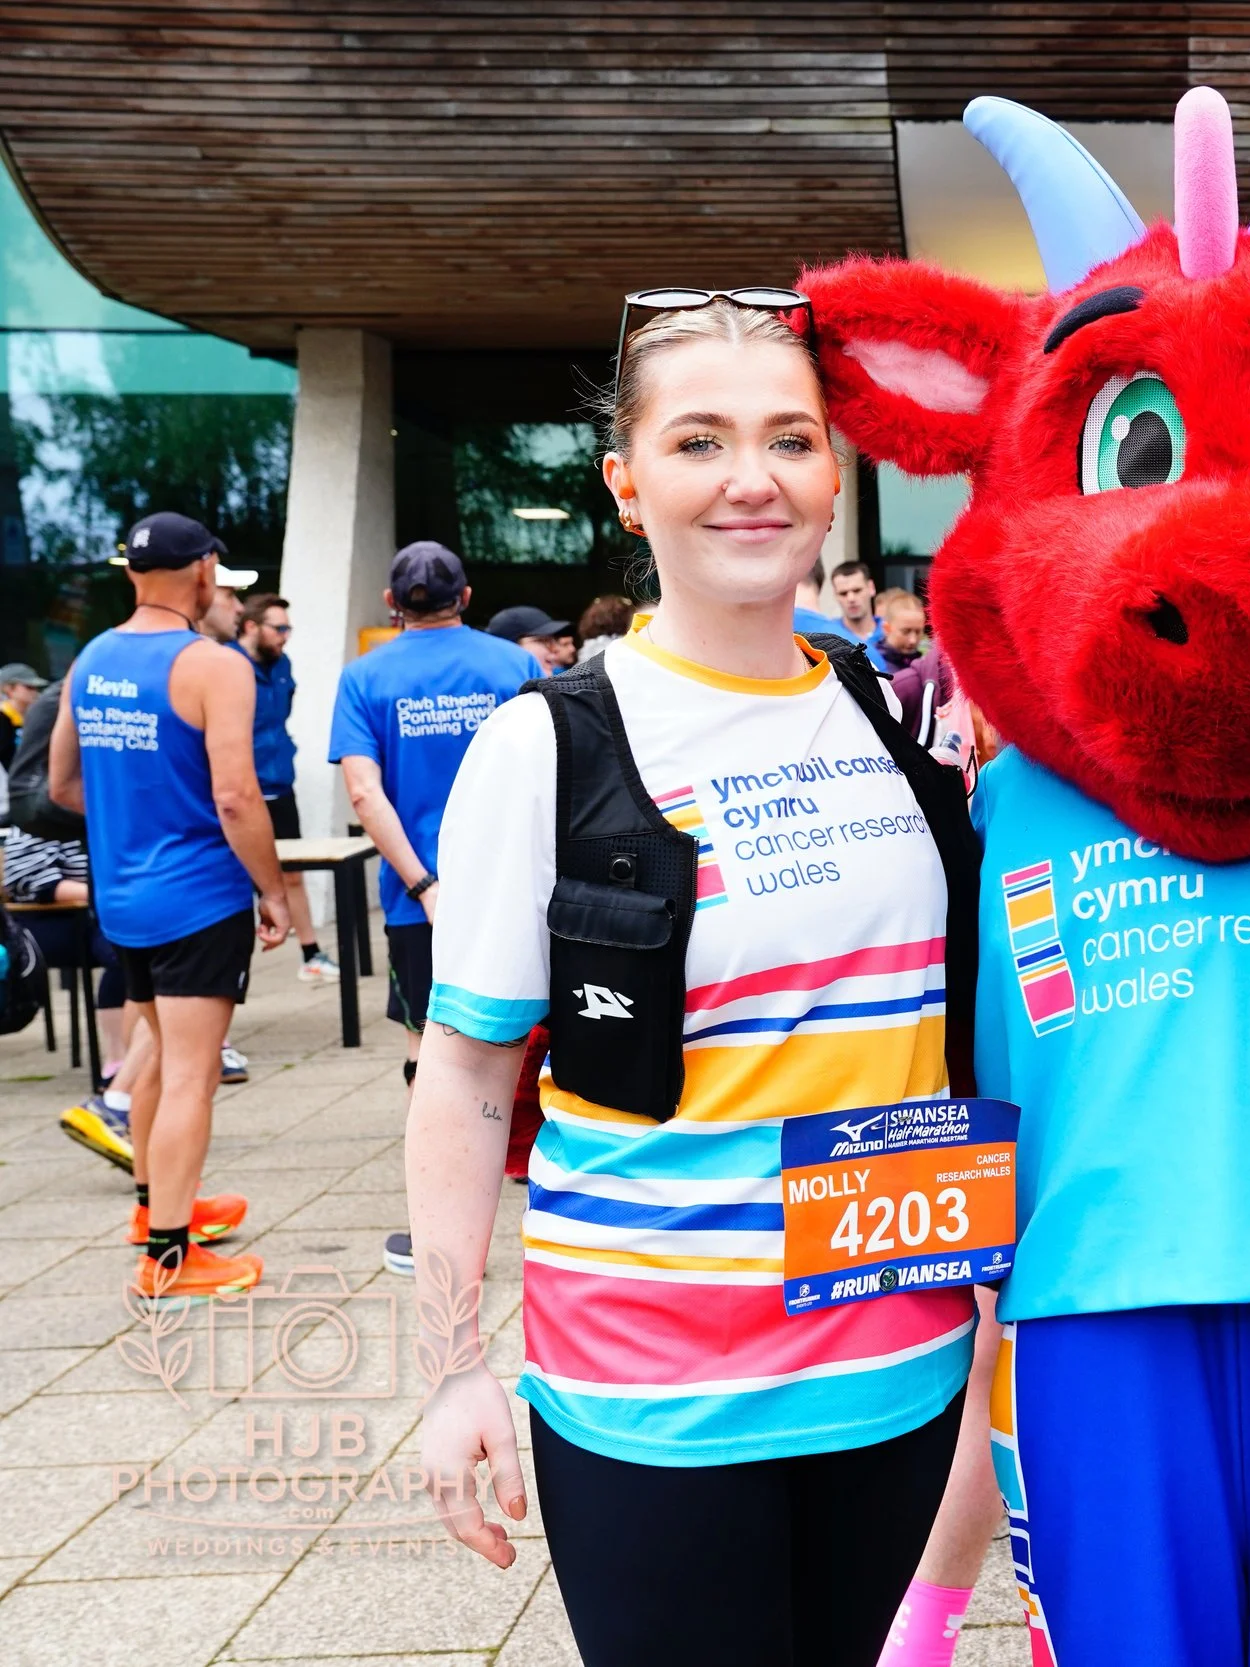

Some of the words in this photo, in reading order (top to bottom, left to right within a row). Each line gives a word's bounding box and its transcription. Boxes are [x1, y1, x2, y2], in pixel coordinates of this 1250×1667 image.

[86, 674, 138, 698] Kevin
[396, 696, 434, 712] Clwb
[437, 692, 496, 708] Rhedeg
[105, 707, 158, 728] Rhedeg
[400, 721, 461, 738] Running
[78, 721, 158, 739] ontardawe
[78, 735, 124, 752] unning
[125, 736, 159, 752] Club
[711, 756, 836, 804] ymchwil
[834, 755, 904, 777] canse
[723, 795, 820, 829] cymru
[734, 825, 838, 861] cancer
[747, 859, 841, 897] wales
[1072, 872, 1205, 924] cymru
[1082, 914, 1213, 968] cancer
[1080, 966, 1195, 1015] wales
[890, 1105, 969, 1126] SWANSEA
[830, 1140, 883, 1157] MIZUNO
[908, 1138, 939, 1147] MARATHON
[976, 1152, 1010, 1165] CANCER
[788, 1169, 871, 1204] MOLLY
[936, 1169, 982, 1183] RESEARCH
[982, 1166, 1011, 1178] WALES
[830, 1187, 969, 1257] 4203
[831, 1260, 971, 1300] #RUNWANSEA
